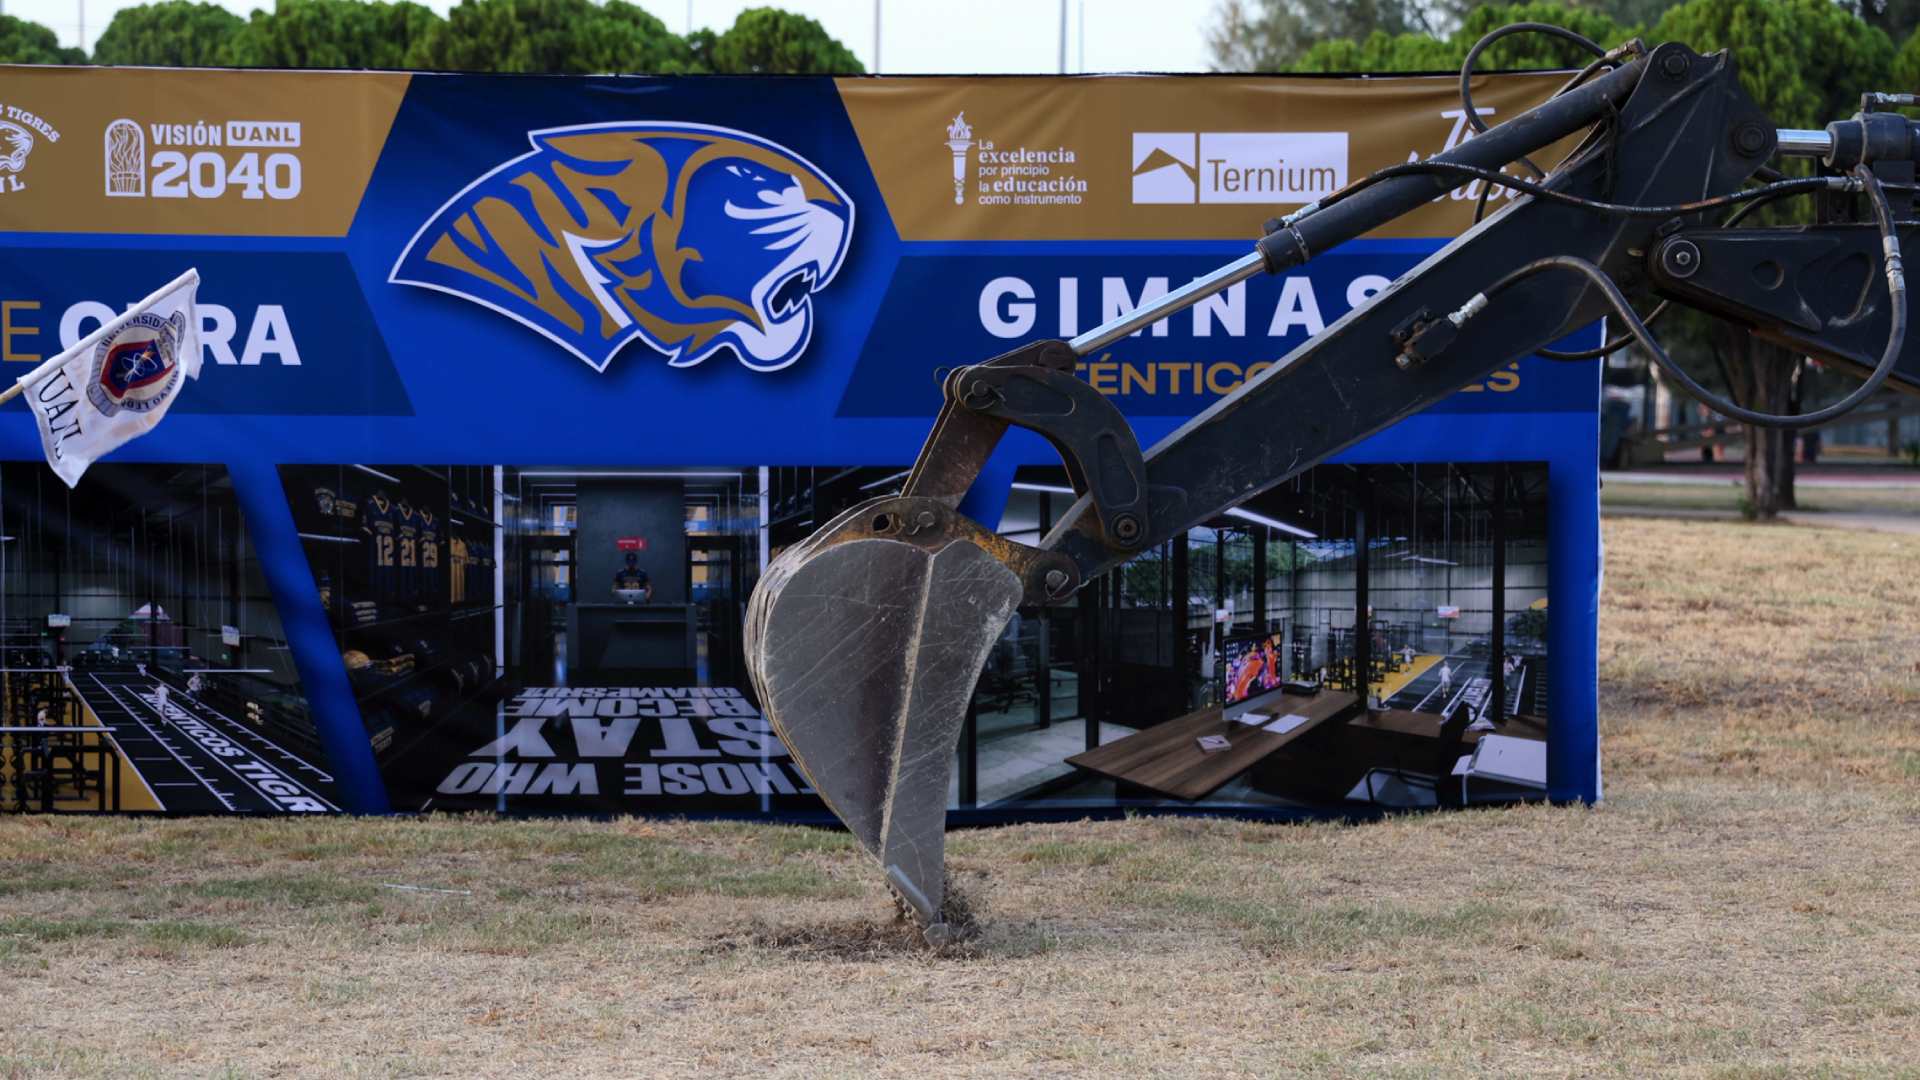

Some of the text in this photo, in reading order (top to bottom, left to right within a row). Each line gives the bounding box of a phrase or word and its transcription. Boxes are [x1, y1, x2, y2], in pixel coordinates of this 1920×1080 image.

[7, 105, 61, 142] TIGRES
[151, 120, 296, 146] VISIÓN UANL
[978, 139, 994, 150] La
[978, 147, 1075, 163] excelencia
[151, 151, 301, 200] 2040
[978, 164, 1050, 178] por principio
[978, 176, 1088, 192] la educación
[1207, 159, 1336, 192] Ternium
[978, 194, 1082, 205] como instrumento
[59, 301, 301, 365] ORA
[376, 535, 394, 566] 12
[401, 539, 416, 567] 21
[500, 698, 757, 717] BECOME
[467, 717, 791, 757] STAY
[436, 763, 600, 794] WHO
